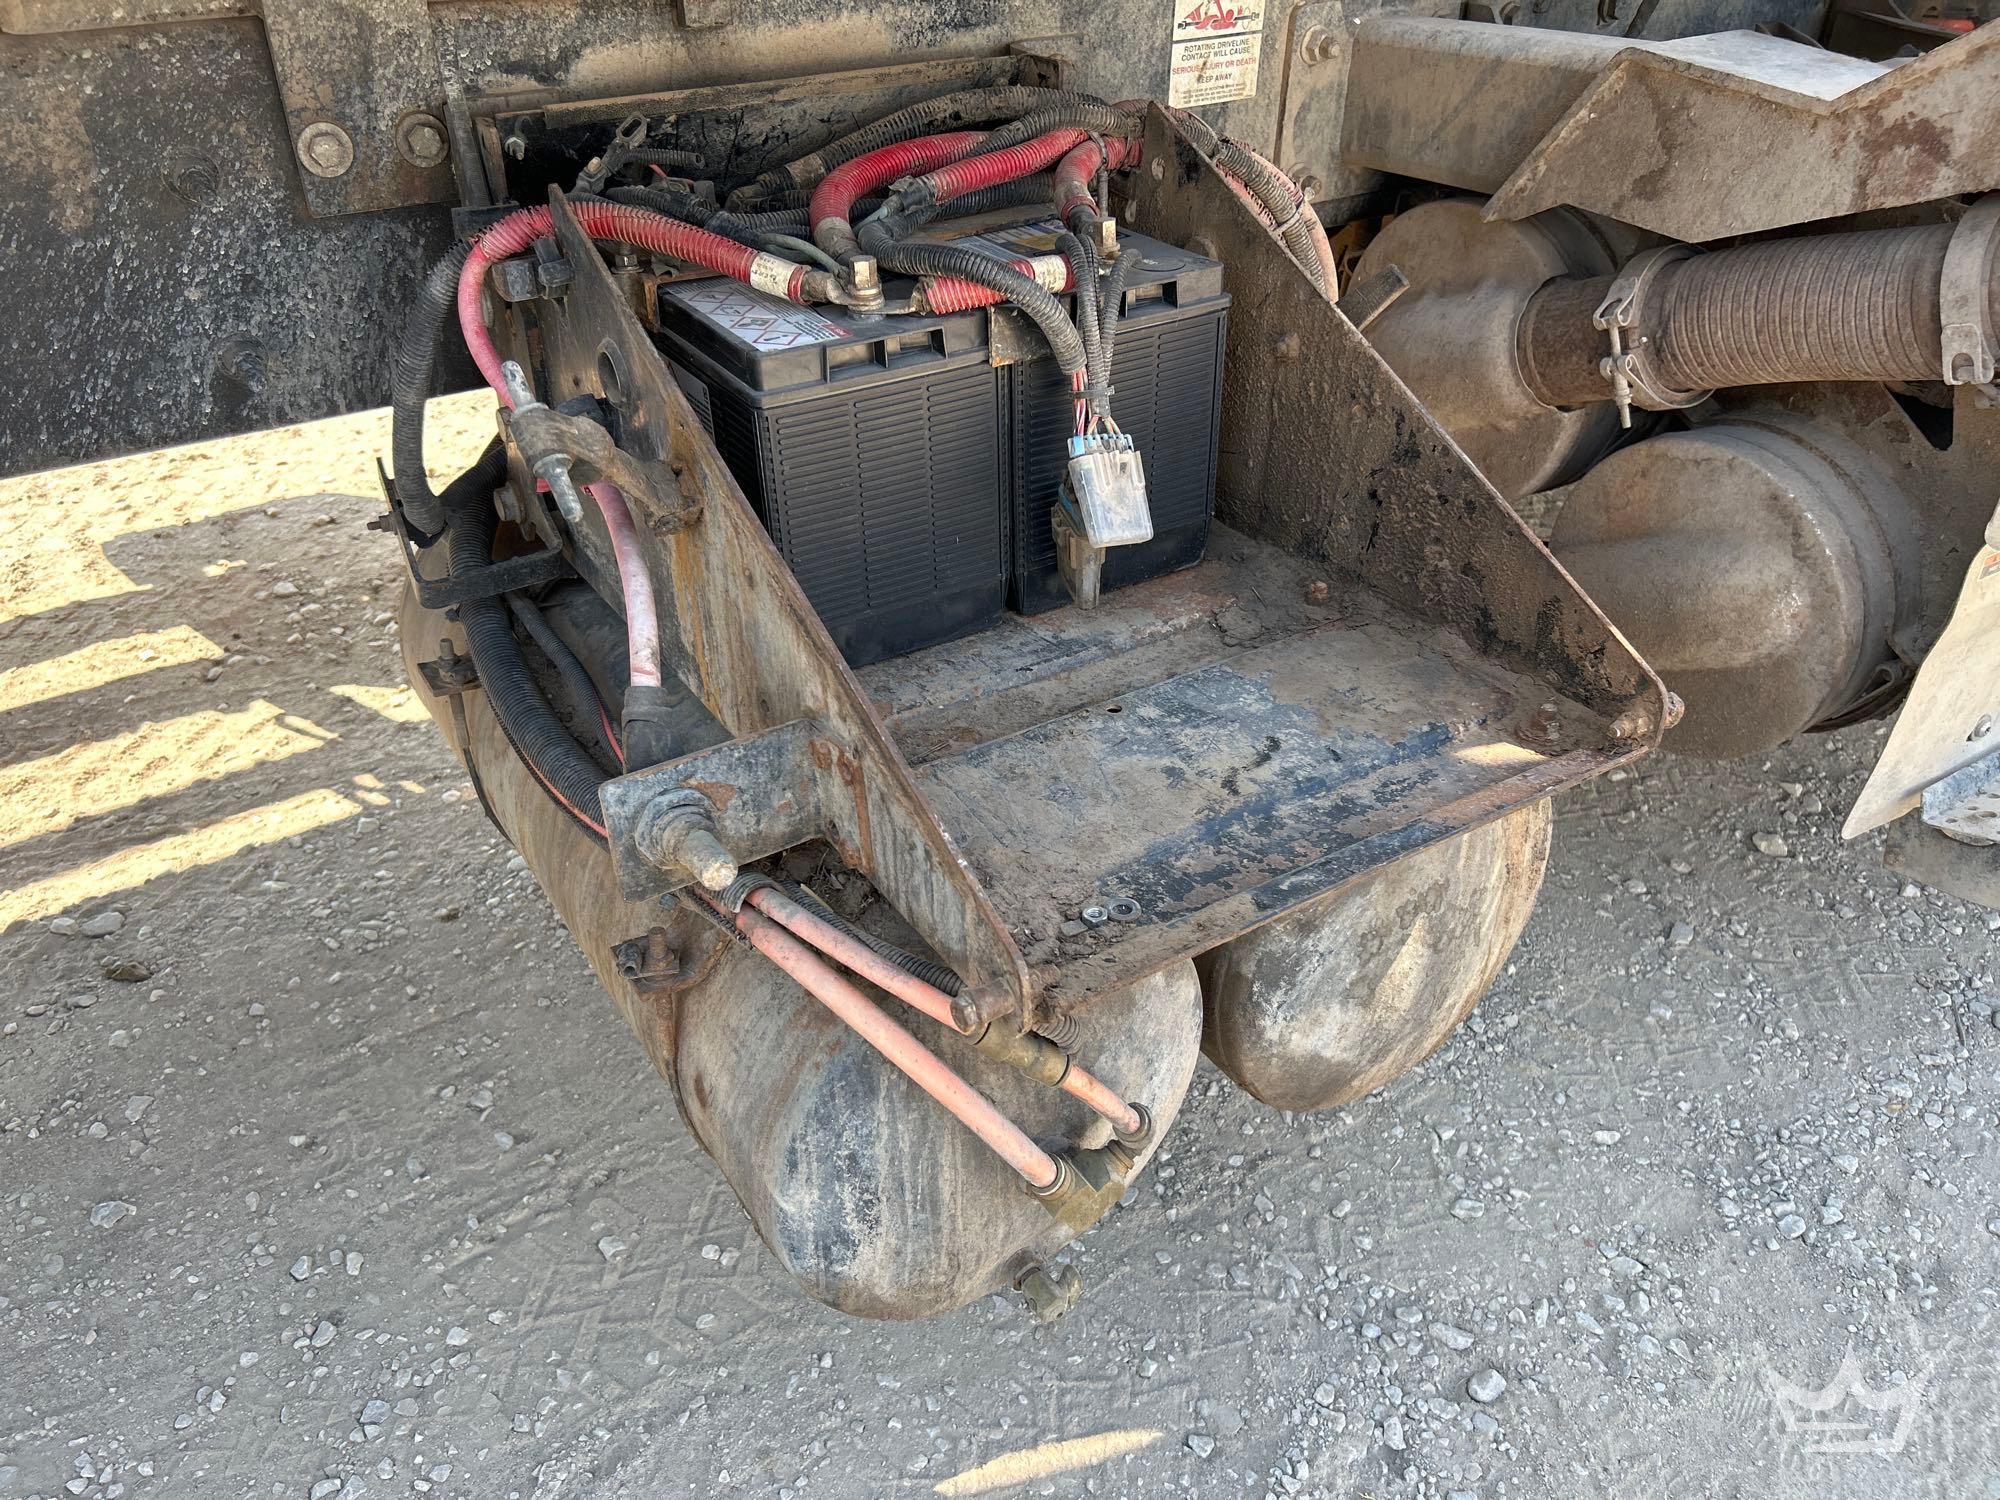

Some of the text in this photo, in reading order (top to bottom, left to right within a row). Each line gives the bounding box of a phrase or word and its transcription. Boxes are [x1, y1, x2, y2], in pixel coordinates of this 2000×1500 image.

[1184, 38, 1250, 53] ROTATING DRIVELINE
[1181, 46, 1250, 61] CONTACT WILL CAUSE
[1172, 64, 1201, 75] SERIOUS
[1225, 60, 1235, 68] OR
[1236, 57, 1256, 67] DEATH
[1197, 72, 1232, 84] EEP AWAY
